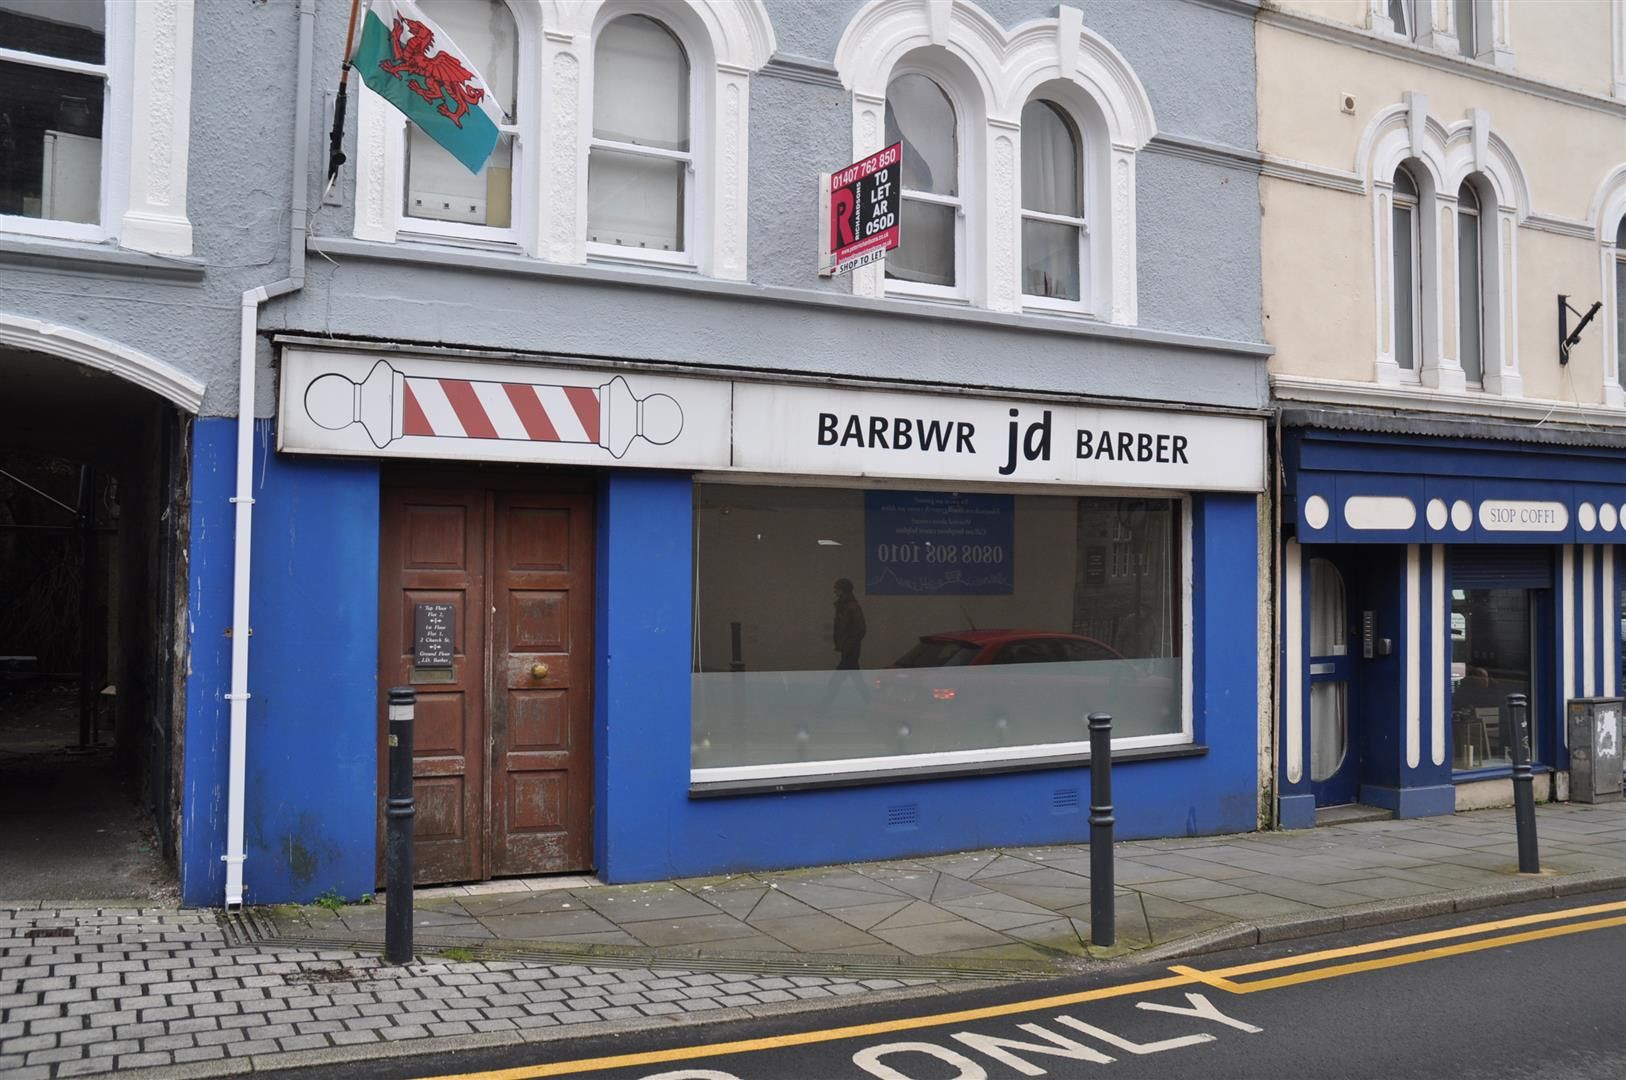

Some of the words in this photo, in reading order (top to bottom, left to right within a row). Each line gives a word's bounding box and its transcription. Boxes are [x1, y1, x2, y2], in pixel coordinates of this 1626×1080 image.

[833, 166, 859, 189] 01407
[861, 158, 877, 177] 762
[879, 148, 896, 169] 850
[874, 169, 888, 186] TO
[871, 182, 891, 203] LET
[872, 200, 888, 218] AR
[866, 212, 895, 235] OSOD
[839, 259, 858, 273] SHOP
[860, 255, 869, 264] TO
[871, 250, 883, 260] LET
[817, 412, 976, 454] BARBWR
[998, 408, 1053, 476] jd
[1076, 429, 1189, 464] BARBER
[1490, 507, 1517, 523] SIOP
[1520, 508, 1555, 524] COFFI
[851, 992, 1264, 1080] ONLY
